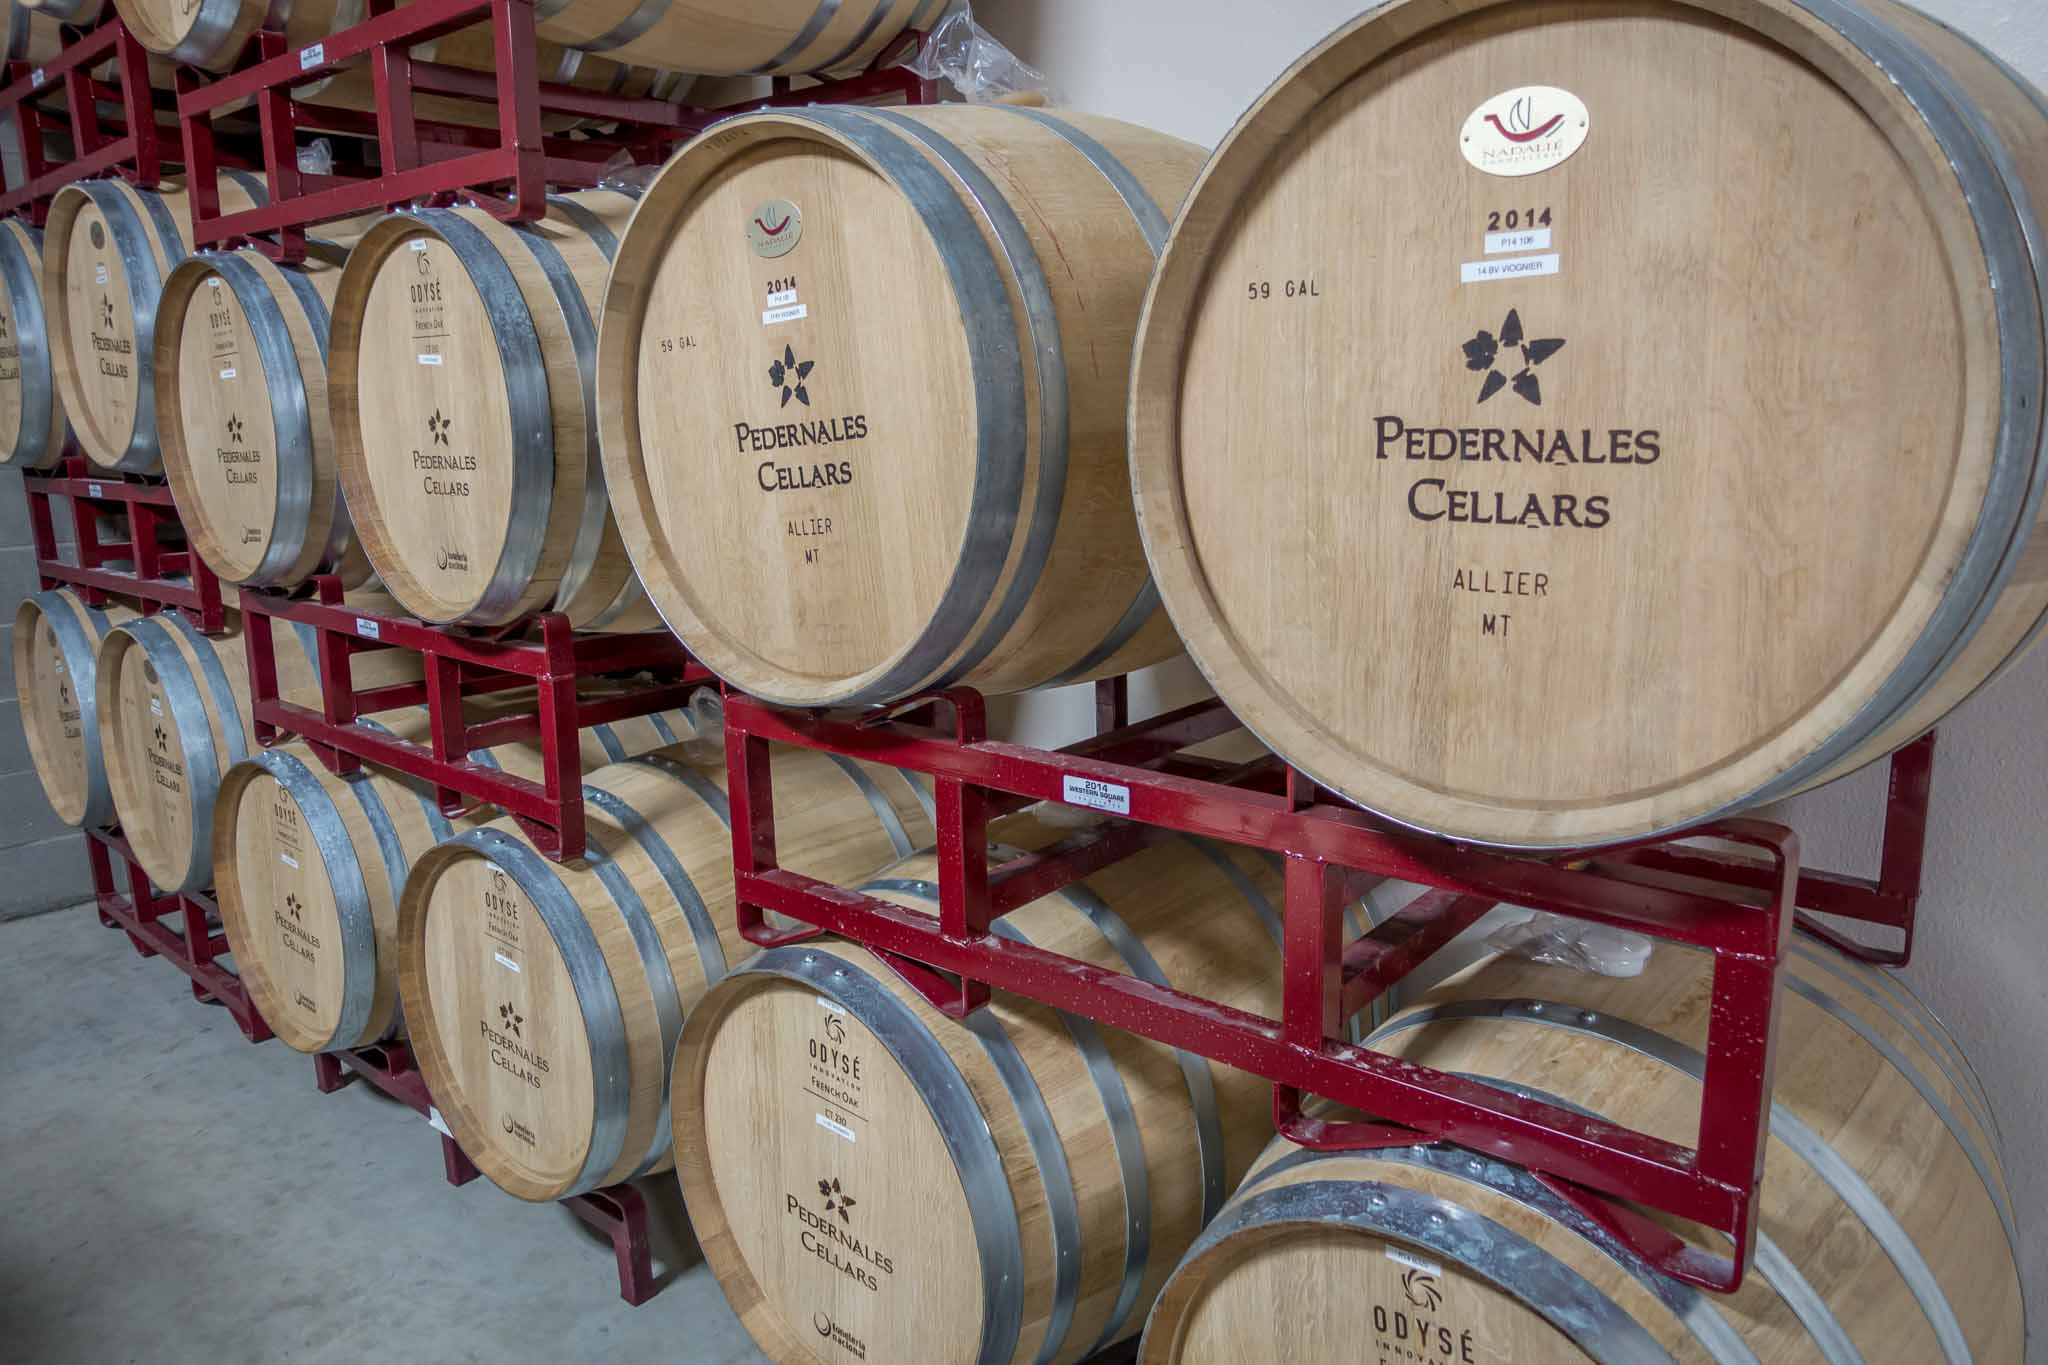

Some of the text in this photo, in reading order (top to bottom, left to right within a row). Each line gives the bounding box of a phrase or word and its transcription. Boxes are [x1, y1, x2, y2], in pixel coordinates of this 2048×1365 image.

[1488, 206, 1552, 231] 2014
[1502, 261, 1543, 273] VIOGNIER
[410, 277, 442, 304] ODYSÉ
[767, 276, 796, 295] 2014
[1248, 279, 1320, 300] 59 GAL
[660, 335, 696, 352] 59 GAL
[734, 414, 869, 452] PEDERNALES
[1373, 415, 1662, 466] PEDERNALES
[412, 449, 477, 471] PEDERNALES
[225, 467, 258, 484] CELLARS
[423, 475, 470, 497] CELLARS
[758, 461, 853, 492] CELLARS
[1407, 477, 1611, 529] CELLARS
[788, 517, 833, 537] ALLIER
[804, 548, 820, 564] MT
[1452, 567, 1549, 596] ALLIER
[1481, 612, 1512, 637] MT
[1069, 784, 1099, 797] WESTERN
[1100, 791, 1125, 803] SQUARE
[1085, 780, 1108, 792] 2014
[480, 1019, 551, 1073] PEDERNALES
[809, 1038, 861, 1080] ODYSÉ
[491, 1048, 542, 1090] CELLARS
[811, 1075, 859, 1108] FRENCH OAK
[786, 1193, 894, 1275] PEDERNALES
[801, 1230, 879, 1292] CELLARS
[1373, 1304, 1475, 1365] ODYSÉ
